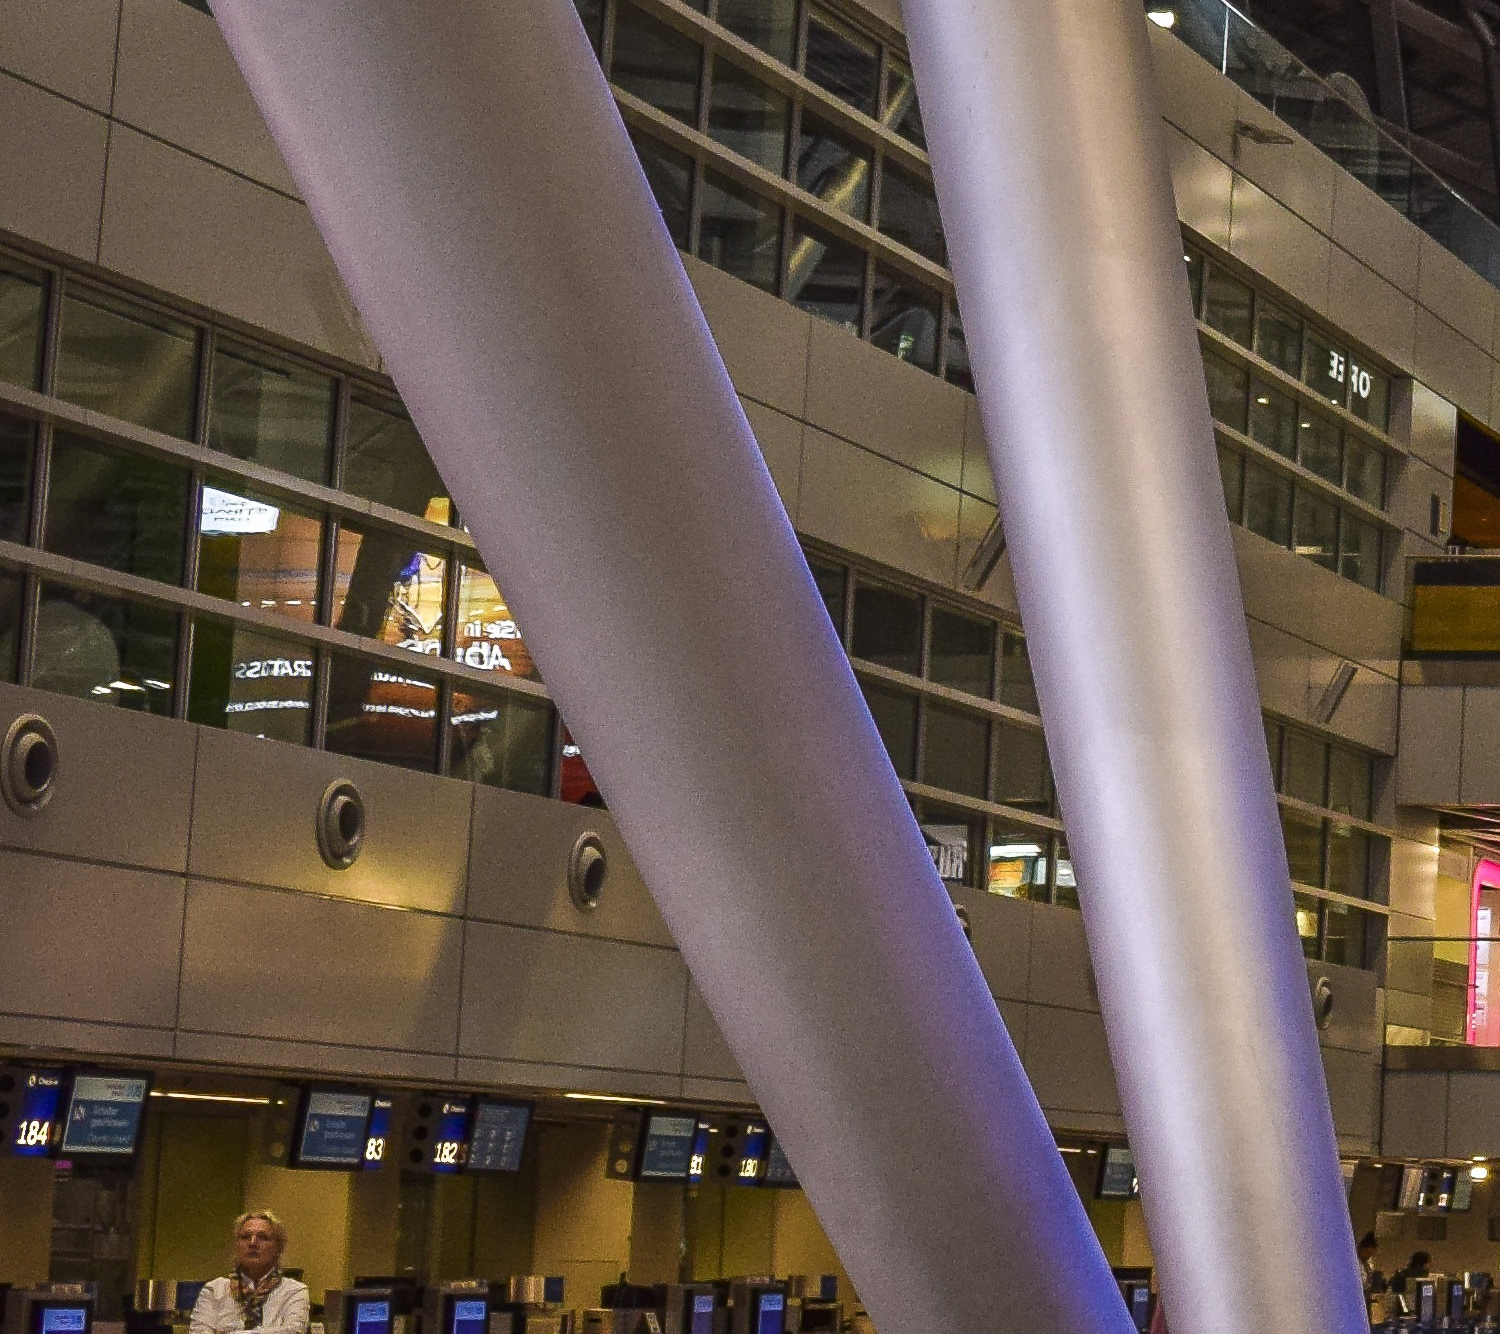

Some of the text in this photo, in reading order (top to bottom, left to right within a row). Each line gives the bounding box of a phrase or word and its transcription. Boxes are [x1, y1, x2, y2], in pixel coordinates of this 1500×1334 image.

[16, 1120, 49, 1146] 184
[365, 1137, 385, 1161] 83
[434, 1142, 459, 1164] 182
